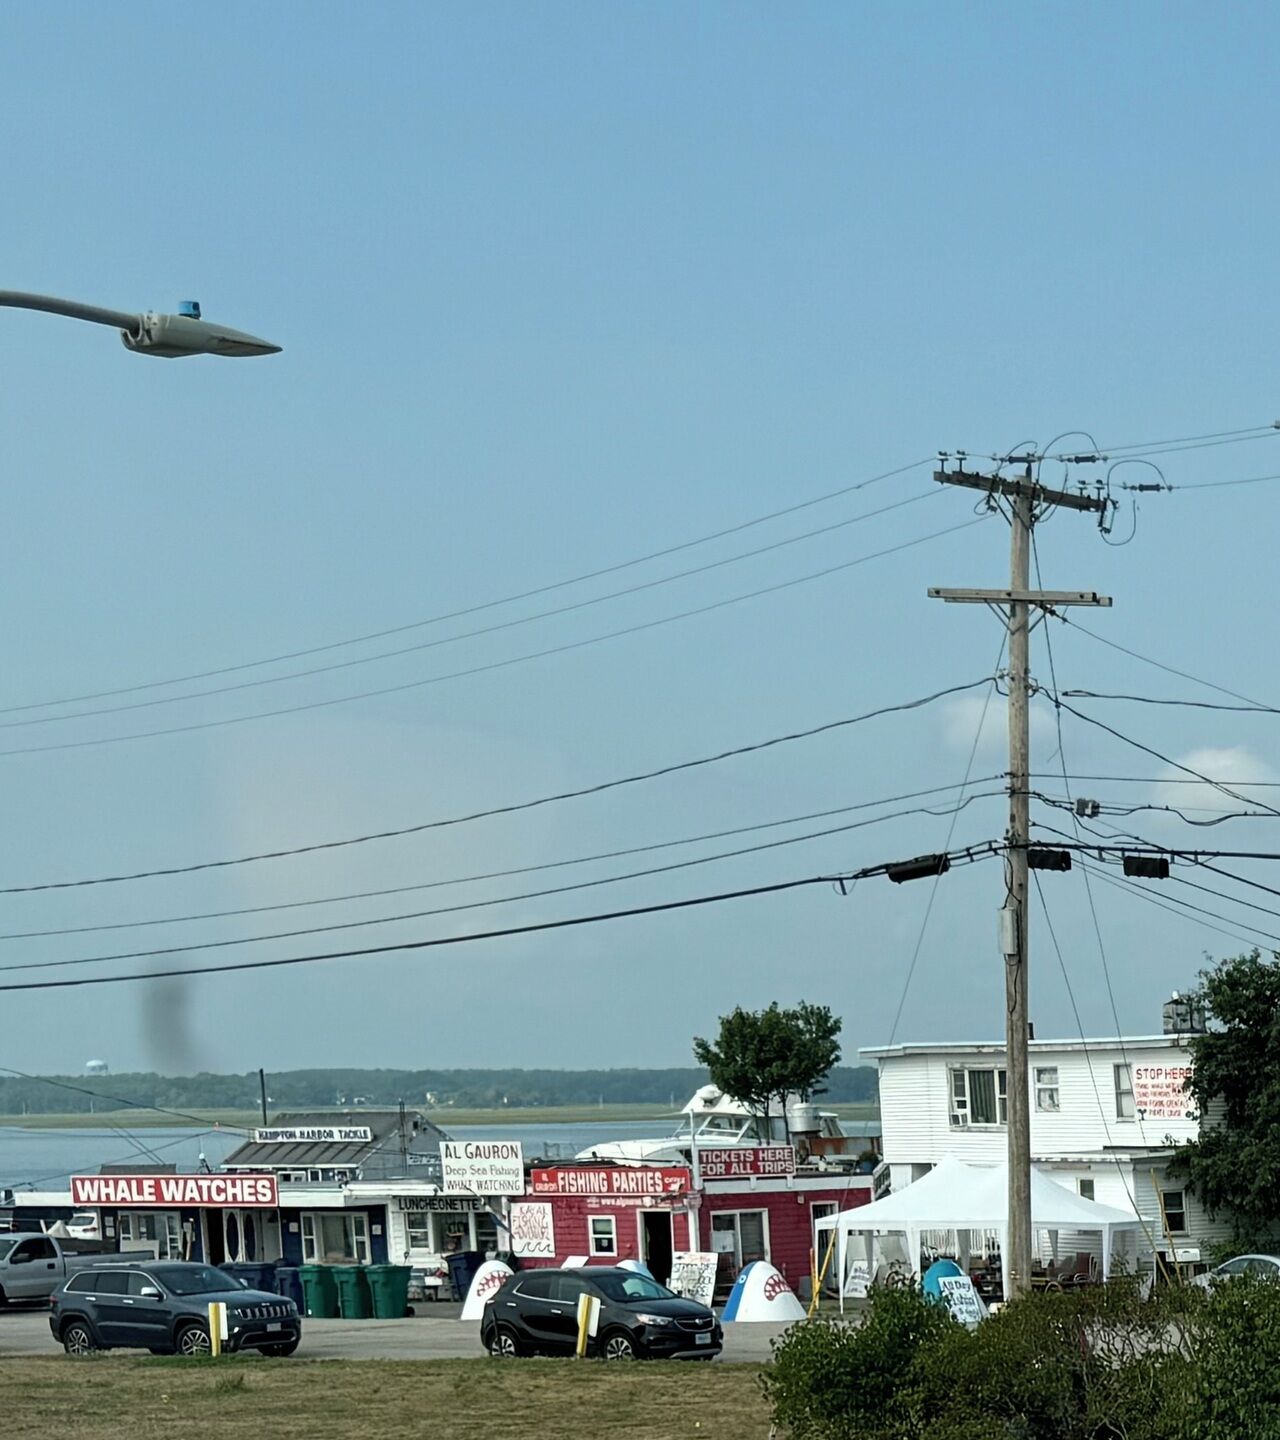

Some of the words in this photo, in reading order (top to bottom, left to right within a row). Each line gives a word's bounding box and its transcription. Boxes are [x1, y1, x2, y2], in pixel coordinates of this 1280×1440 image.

[1136, 1068, 1163, 1079] STOP
[445, 1143, 462, 1159] AL
[464, 1142, 519, 1160] GAURON
[700, 1149, 754, 1163] TICKETS
[759, 1148, 792, 1161] HERE
[469, 1164, 488, 1176] Sea
[700, 1163, 726, 1175] FOR
[730, 1162, 754, 1174] ALL
[757, 1161, 794, 1173] TRIPS
[557, 1171, 608, 1193] FISHING
[612, 1171, 663, 1193] PARTIES
[76, 1179, 156, 1202] WHALE
[160, 1179, 272, 1202] WATCHES
[398, 1196, 480, 1210] LUNCHEONETTE
